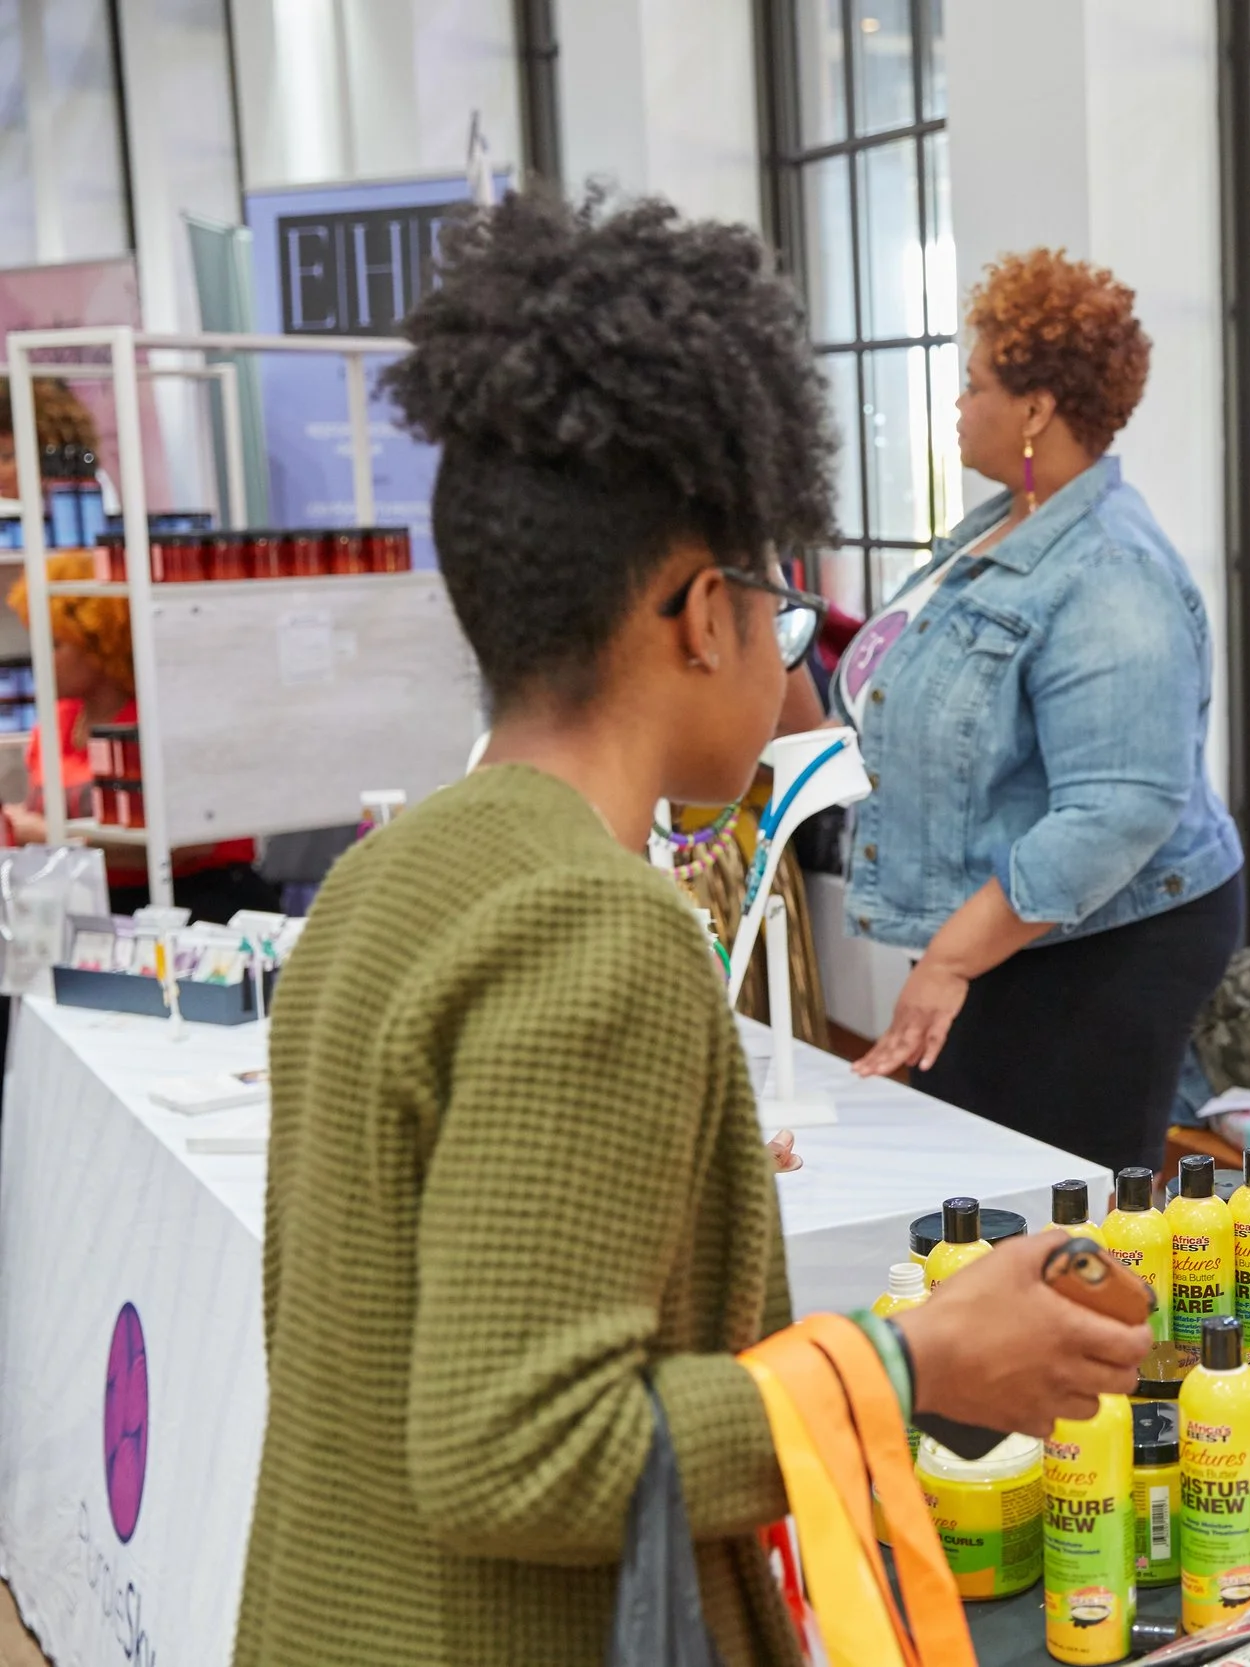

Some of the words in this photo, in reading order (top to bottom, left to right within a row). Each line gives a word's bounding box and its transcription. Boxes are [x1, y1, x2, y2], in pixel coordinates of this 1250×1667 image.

[1172, 1235, 1210, 1244] Africa's
[1172, 1243, 1210, 1252] BEST
[1172, 1255, 1221, 1271] extures
[1189, 1273, 1215, 1282] Butter
[1173, 1283, 1225, 1298] ERBAL
[1173, 1299, 1214, 1313] ARE
[1046, 1494, 1115, 1516] STURE
[944, 1535, 984, 1547] CURLS
